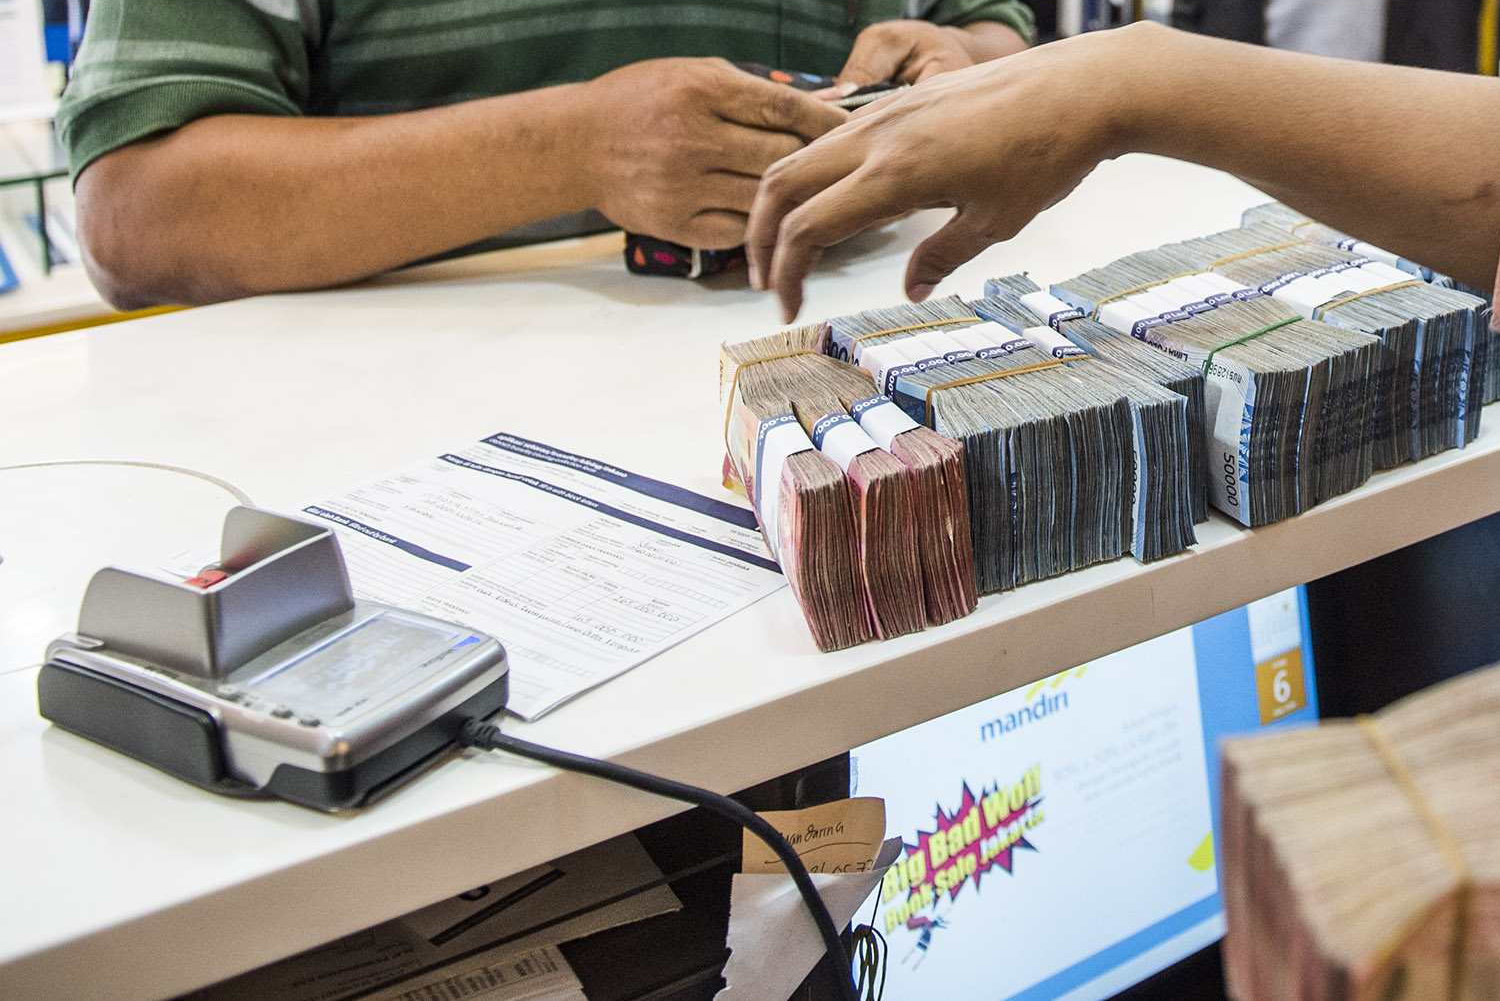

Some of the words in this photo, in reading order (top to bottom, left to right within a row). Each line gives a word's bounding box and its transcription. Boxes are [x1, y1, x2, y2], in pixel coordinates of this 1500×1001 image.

[1223, 452, 1240, 507] 50000
[1273, 669, 1291, 703] 6
[980, 691, 1069, 742] mandiri
[883, 848, 927, 905] Big
[928, 804, 981, 870] Bad
[981, 762, 1041, 830] Wolf
[933, 852, 977, 897] Sale
